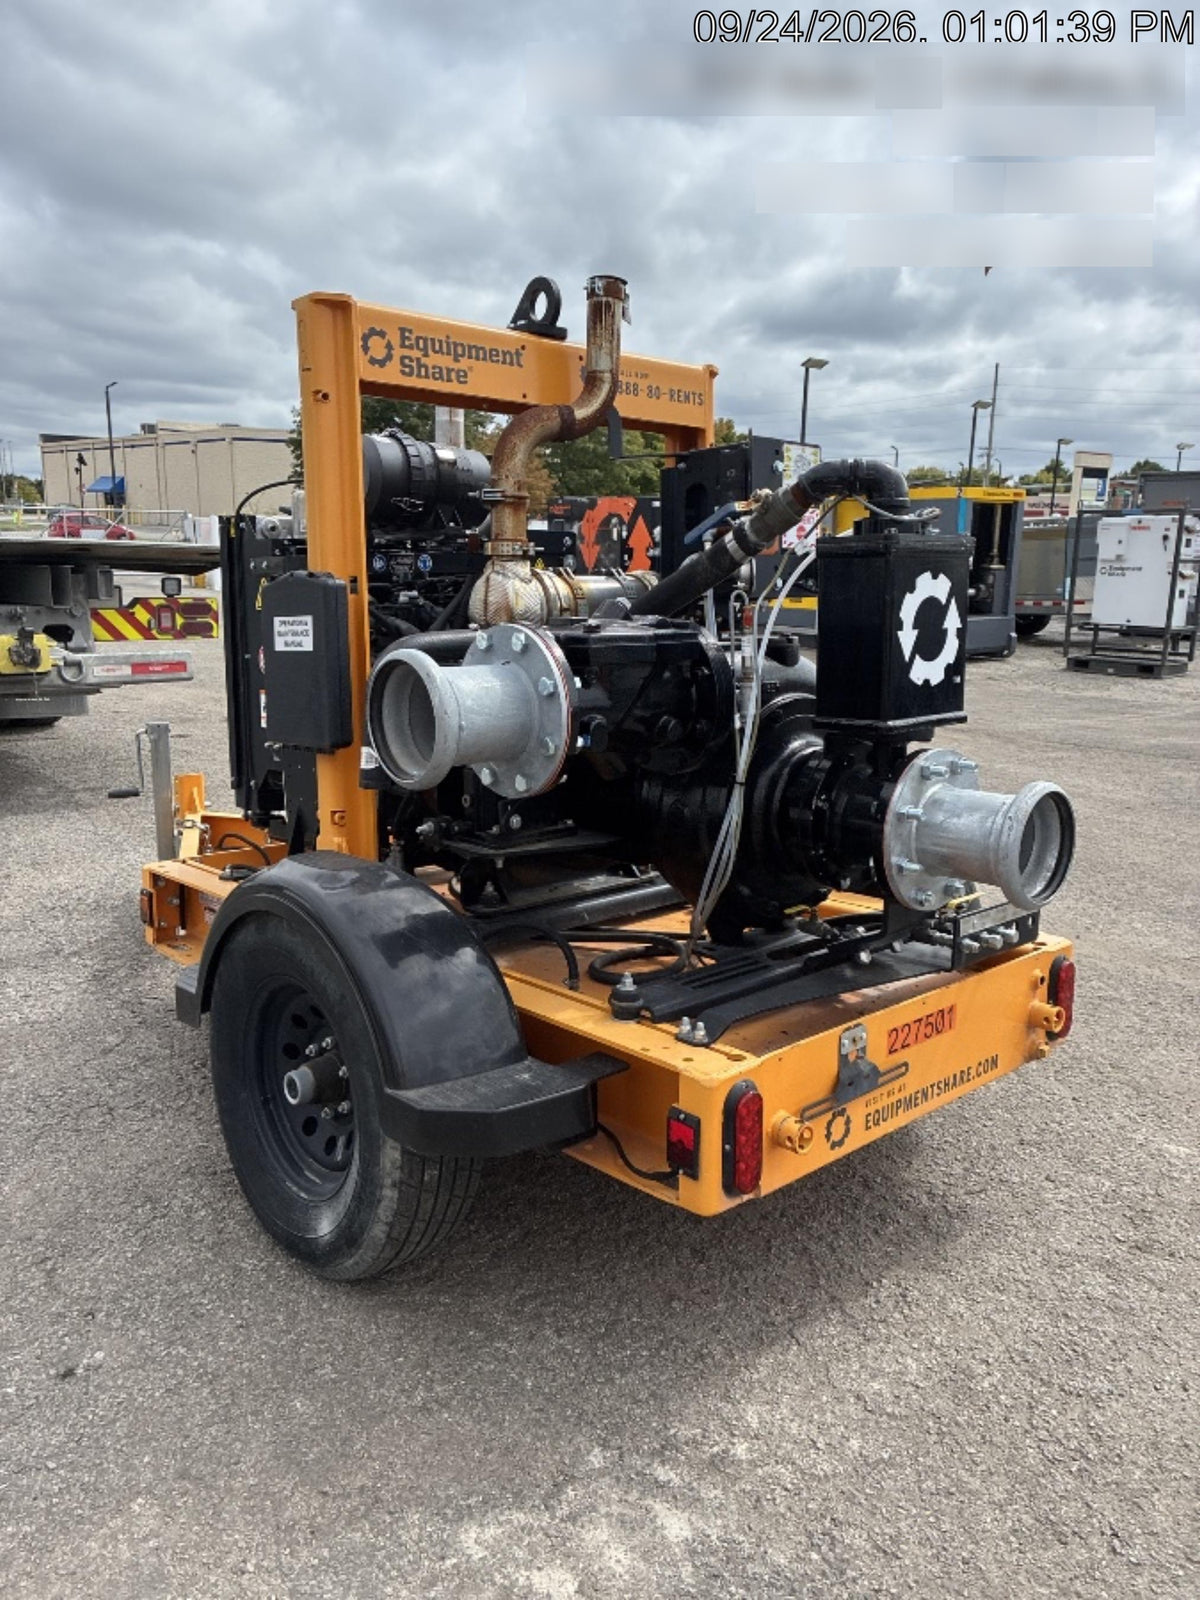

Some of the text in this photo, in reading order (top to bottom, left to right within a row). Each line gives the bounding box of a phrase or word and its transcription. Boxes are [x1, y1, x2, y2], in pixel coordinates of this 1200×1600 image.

[398, 327, 524, 368] Equipment
[399, 354, 469, 384] Share
[887, 1003, 955, 1056] 227501
[864, 1054, 999, 1132] EQUIPMENTSHARE.COM
